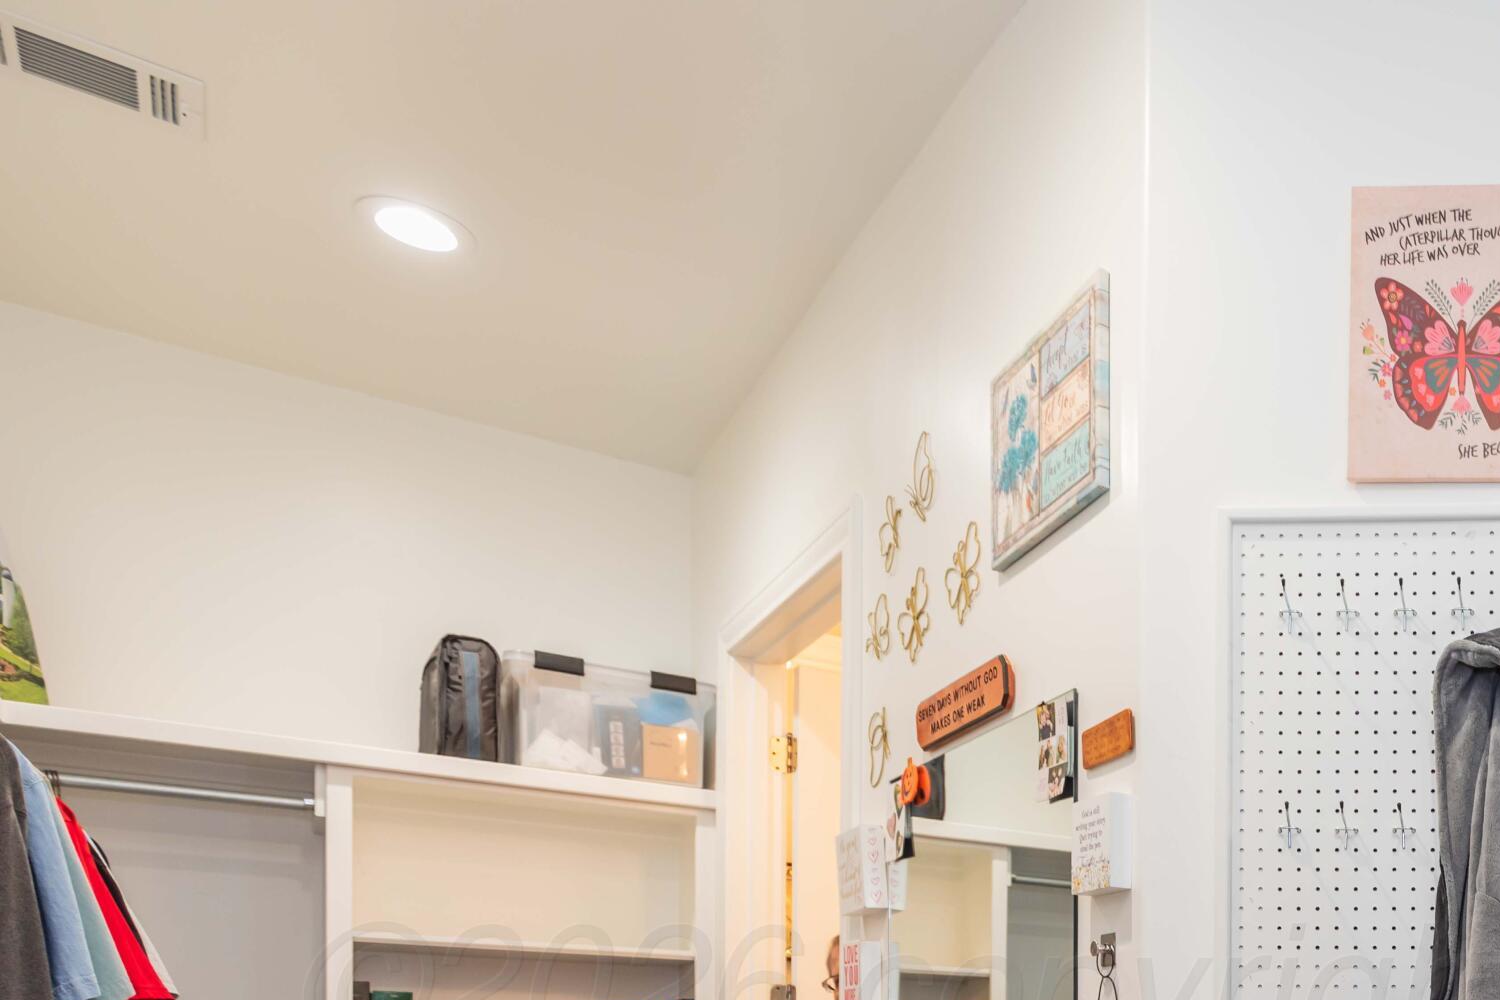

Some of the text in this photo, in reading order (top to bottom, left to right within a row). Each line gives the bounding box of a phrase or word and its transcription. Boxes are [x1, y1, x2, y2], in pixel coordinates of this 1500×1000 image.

[1365, 208, 1472, 245] AND JUST WHEN THE
[1399, 229, 1466, 250] CATERPILLAR
[1380, 243, 1481, 266] HER LIFE WAS OVER
[1458, 444, 1478, 459] SHE
[919, 666, 997, 722] SEVEN DAYS WITHOUT GOD
[931, 695, 985, 734] MAKES ONE WEAK
[844, 944, 859, 965] LOVE
[844, 965, 859, 986] YOU
